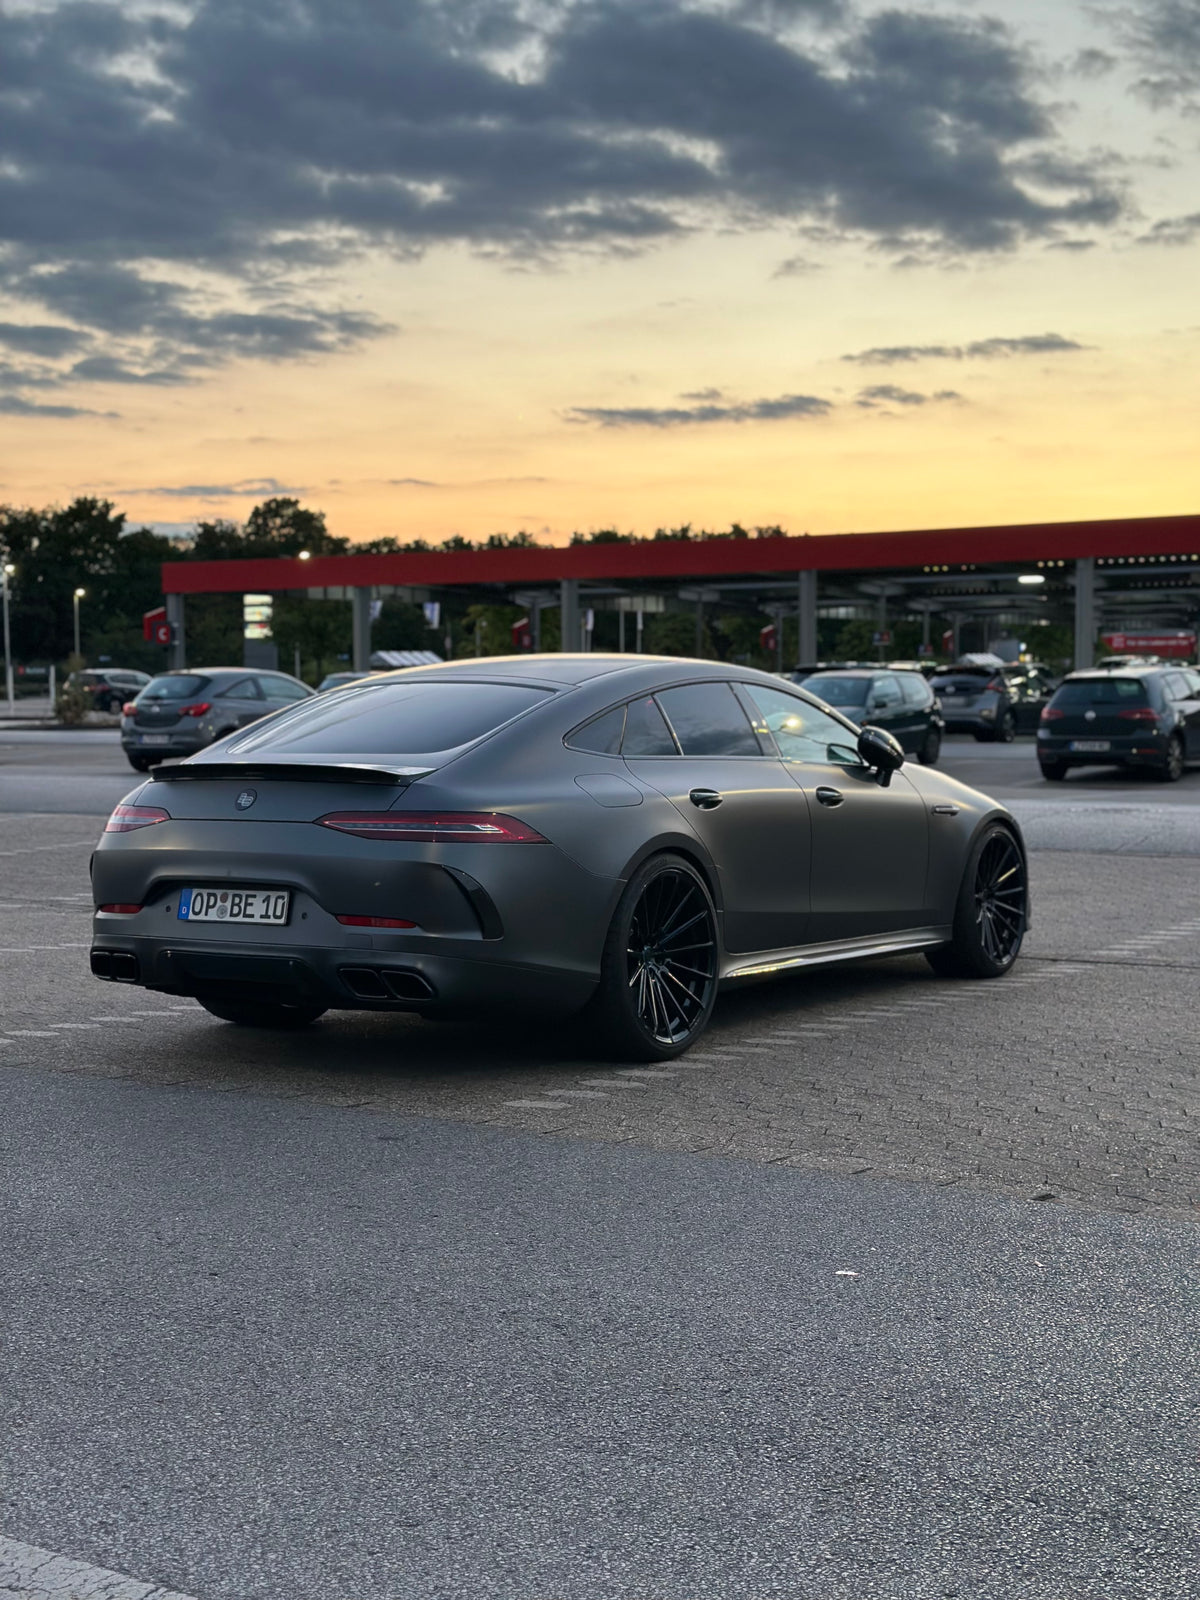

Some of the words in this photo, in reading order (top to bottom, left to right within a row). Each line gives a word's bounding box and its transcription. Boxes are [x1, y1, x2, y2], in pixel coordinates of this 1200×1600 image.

[191, 892, 218, 916] OP
[229, 893, 257, 918] BE
[259, 895, 286, 920] 10
